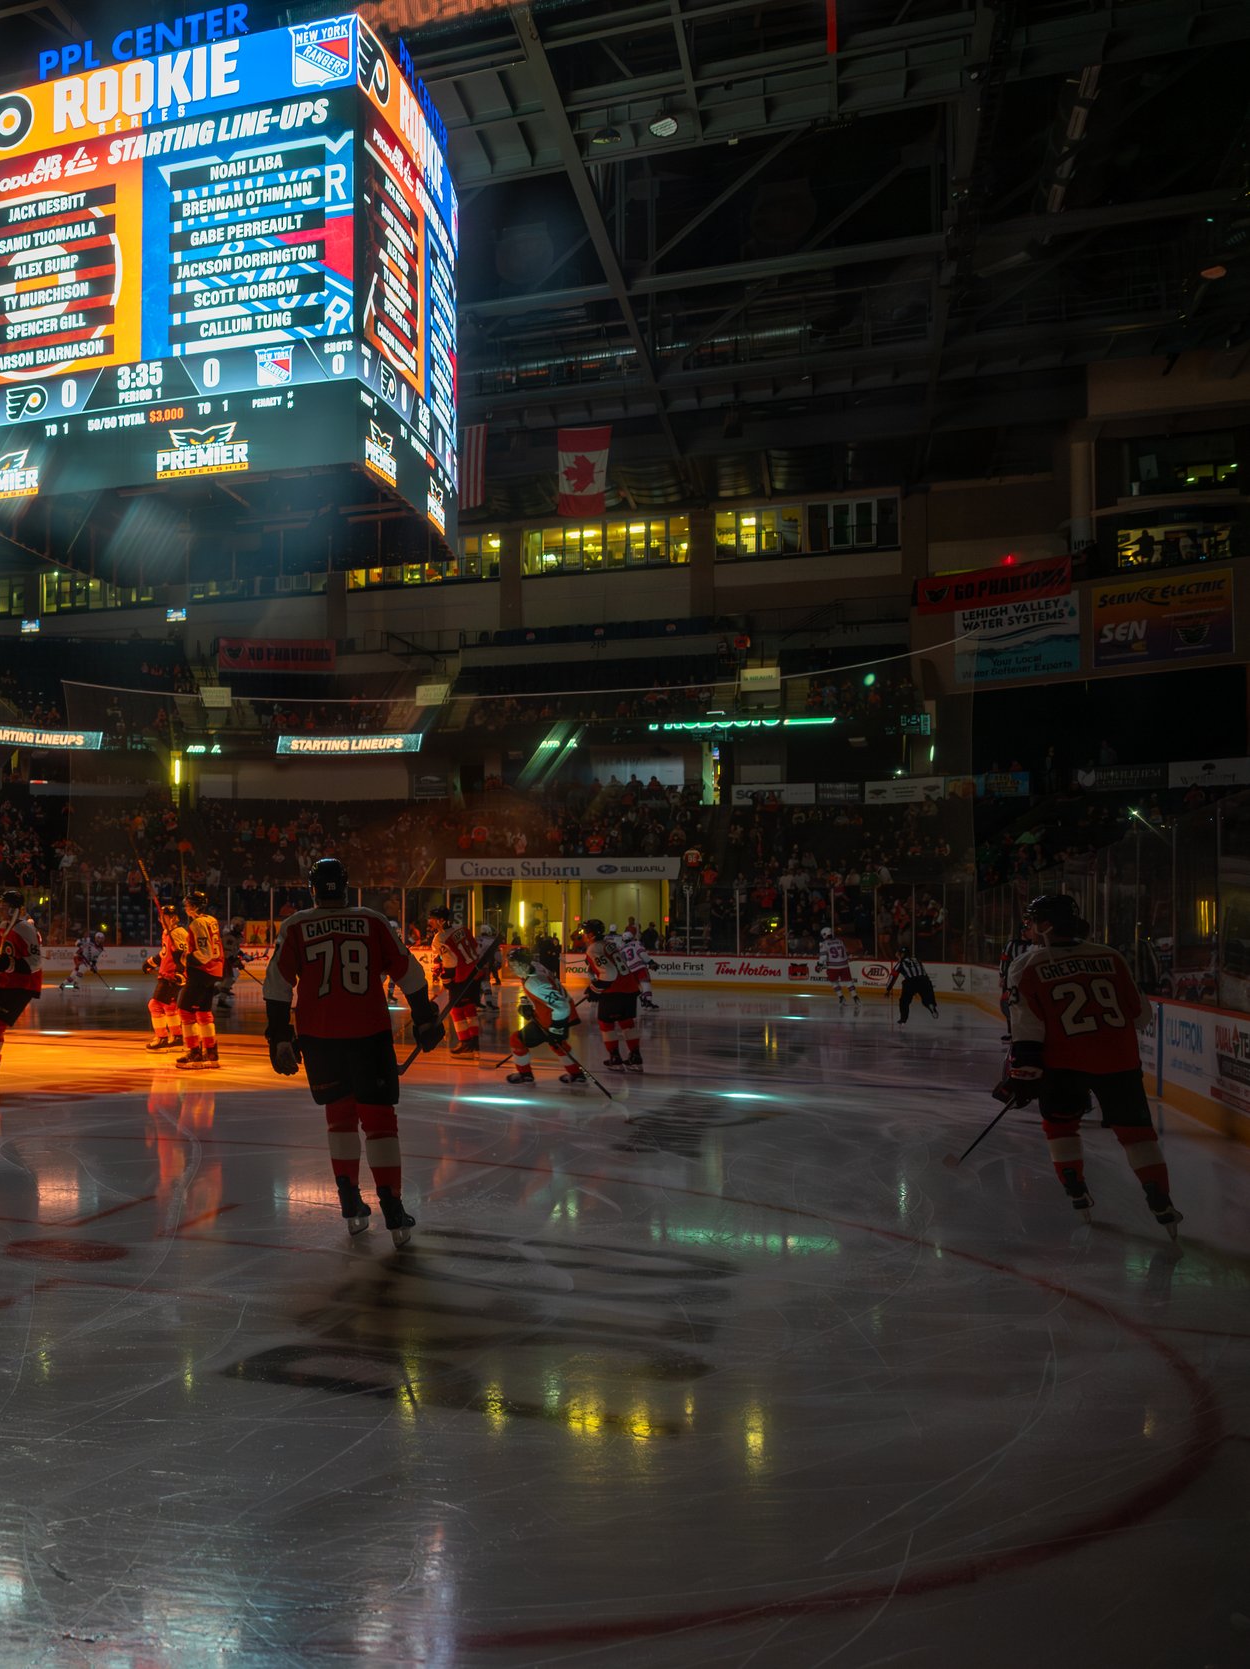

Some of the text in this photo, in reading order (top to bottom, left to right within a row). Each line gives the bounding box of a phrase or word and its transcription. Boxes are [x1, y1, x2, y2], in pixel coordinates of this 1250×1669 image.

[39, 3, 249, 80] PPL CENTER
[295, 24, 349, 44] NEW YORK
[302, 45, 347, 74] RANGERS
[53, 39, 240, 134] ROOKIE
[98, 105, 186, 135] SERIES
[107, 98, 330, 165] STARTING LINE-UPS
[33, 154, 63, 173] AIR
[210, 153, 283, 181] NOAH LABA
[8, 192, 87, 223] JACK NESBITT
[182, 180, 312, 217] BRENNAN OTHMANN
[0, 221, 96, 255] SAMU TUOMAALA
[190, 214, 304, 247] GABE PERREAULT
[14, 254, 79, 280] ALEX BUMP
[177, 244, 317, 280] JACKSON DORRINGTON
[4, 282, 89, 311] TY MURCHISON
[193, 278, 299, 308] SCOTT MORROW
[6, 313, 87, 340] SPENCER GILL
[199, 311, 292, 338] CALLUM TUNG
[35, 339, 104, 363] BJARNASON
[332, 354, 345, 374] 0
[117, 361, 163, 390] 3:35
[202, 358, 221, 388] 0
[61, 379, 78, 408] 0
[118, 387, 162, 404] PERIOD 1
[118, 412, 146, 428] TOTAL
[149, 408, 184, 423] $3,000
[156, 443, 249, 472] PREMIER
[962, 598, 1060, 622] LEHIGH VALLEY
[962, 609, 1066, 631] WATER SYSTEMS
[1099, 618, 1149, 644] SEN
[991, 654, 1042, 667] Your Local
[35, 732, 85, 746] LINEUPS
[290, 737, 404, 751] STARTING LINEUPS
[460, 861, 581, 877] Ciocca Subaru
[620, 864, 666, 873] SUBARU
[306, 919, 365, 938] GAUCHER
[829, 945, 846, 959] 97
[305, 938, 369, 999] 78
[683, 960, 704, 972] First
[715, 960, 782, 977] Tim Hortons
[867, 966, 885, 977] AHL
[1040, 959, 1113, 979] GREBENKIN
[1051, 977, 1126, 1038] 29
